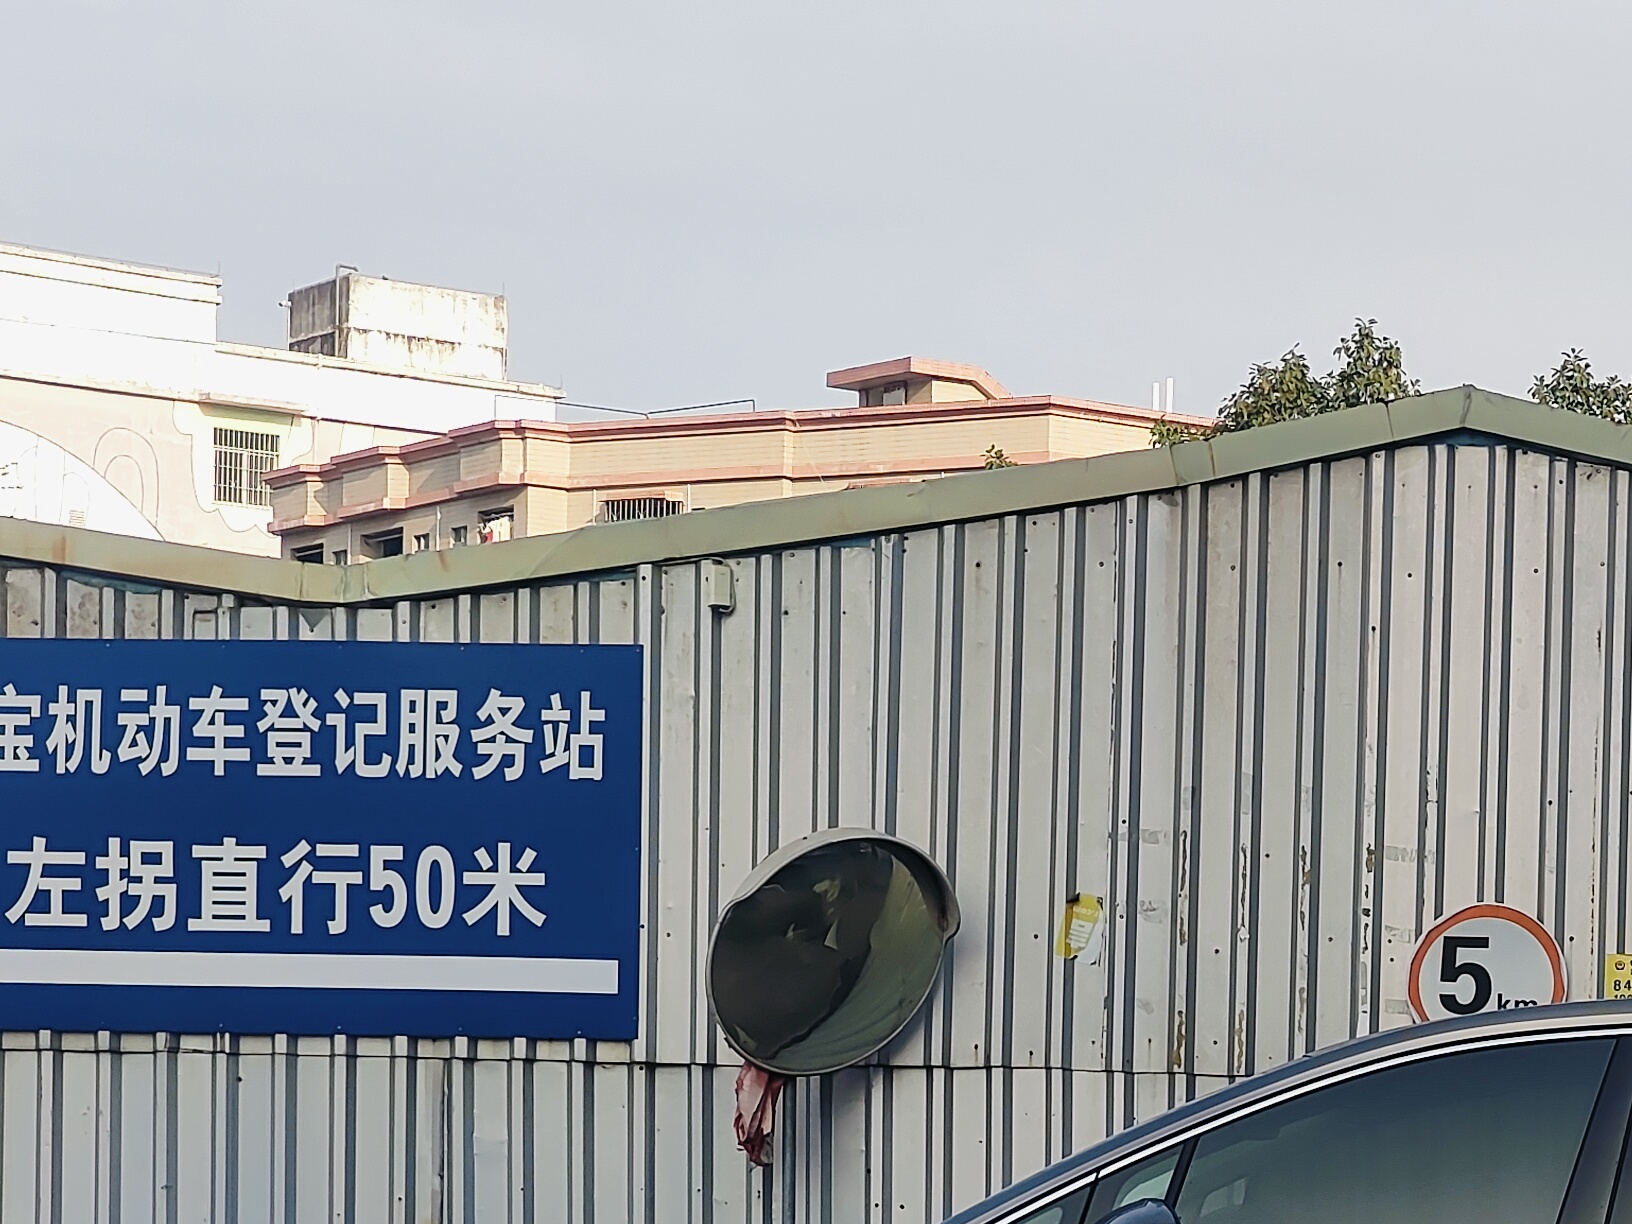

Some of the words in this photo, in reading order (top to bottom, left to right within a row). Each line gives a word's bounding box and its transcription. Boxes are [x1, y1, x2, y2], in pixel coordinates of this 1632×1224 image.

[0, 684, 606, 782] 宝机动车登记服务站
[4, 836, 548, 937] 左拐直行50米
